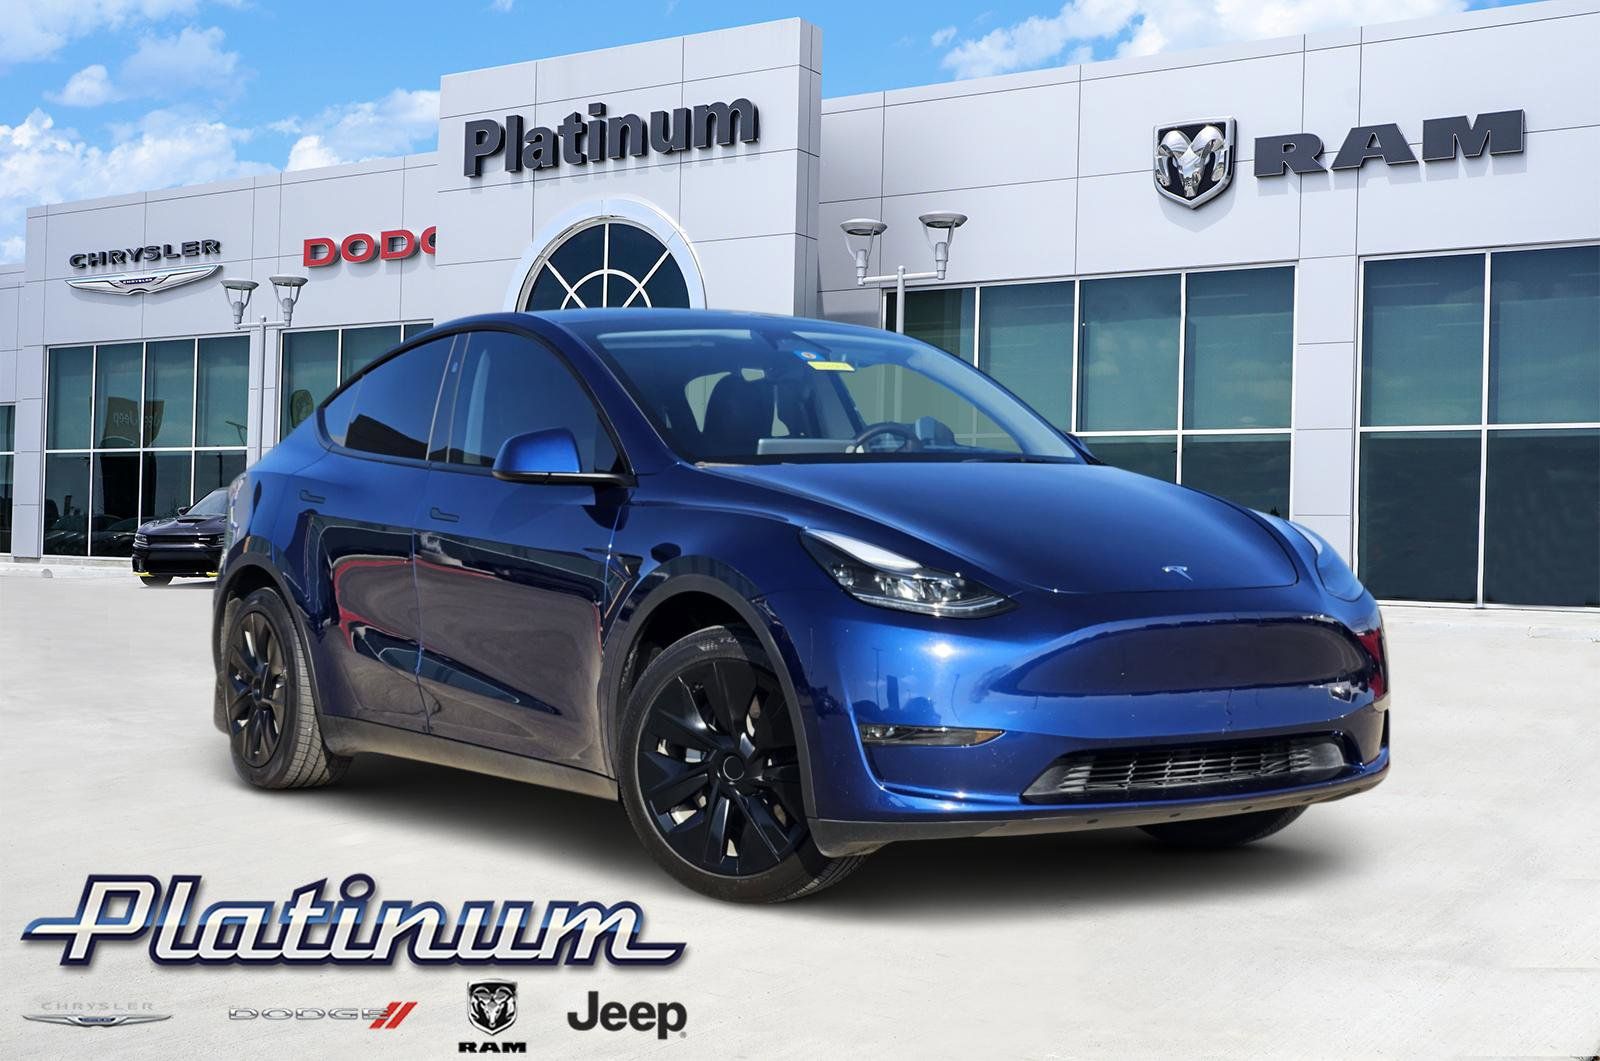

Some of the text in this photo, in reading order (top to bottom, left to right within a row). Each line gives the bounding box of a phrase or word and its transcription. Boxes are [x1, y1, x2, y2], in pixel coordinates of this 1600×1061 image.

[463, 98, 760, 177] Platinum
[1254, 109, 1525, 177] RAM
[69, 239, 221, 269] CHRYSLER
